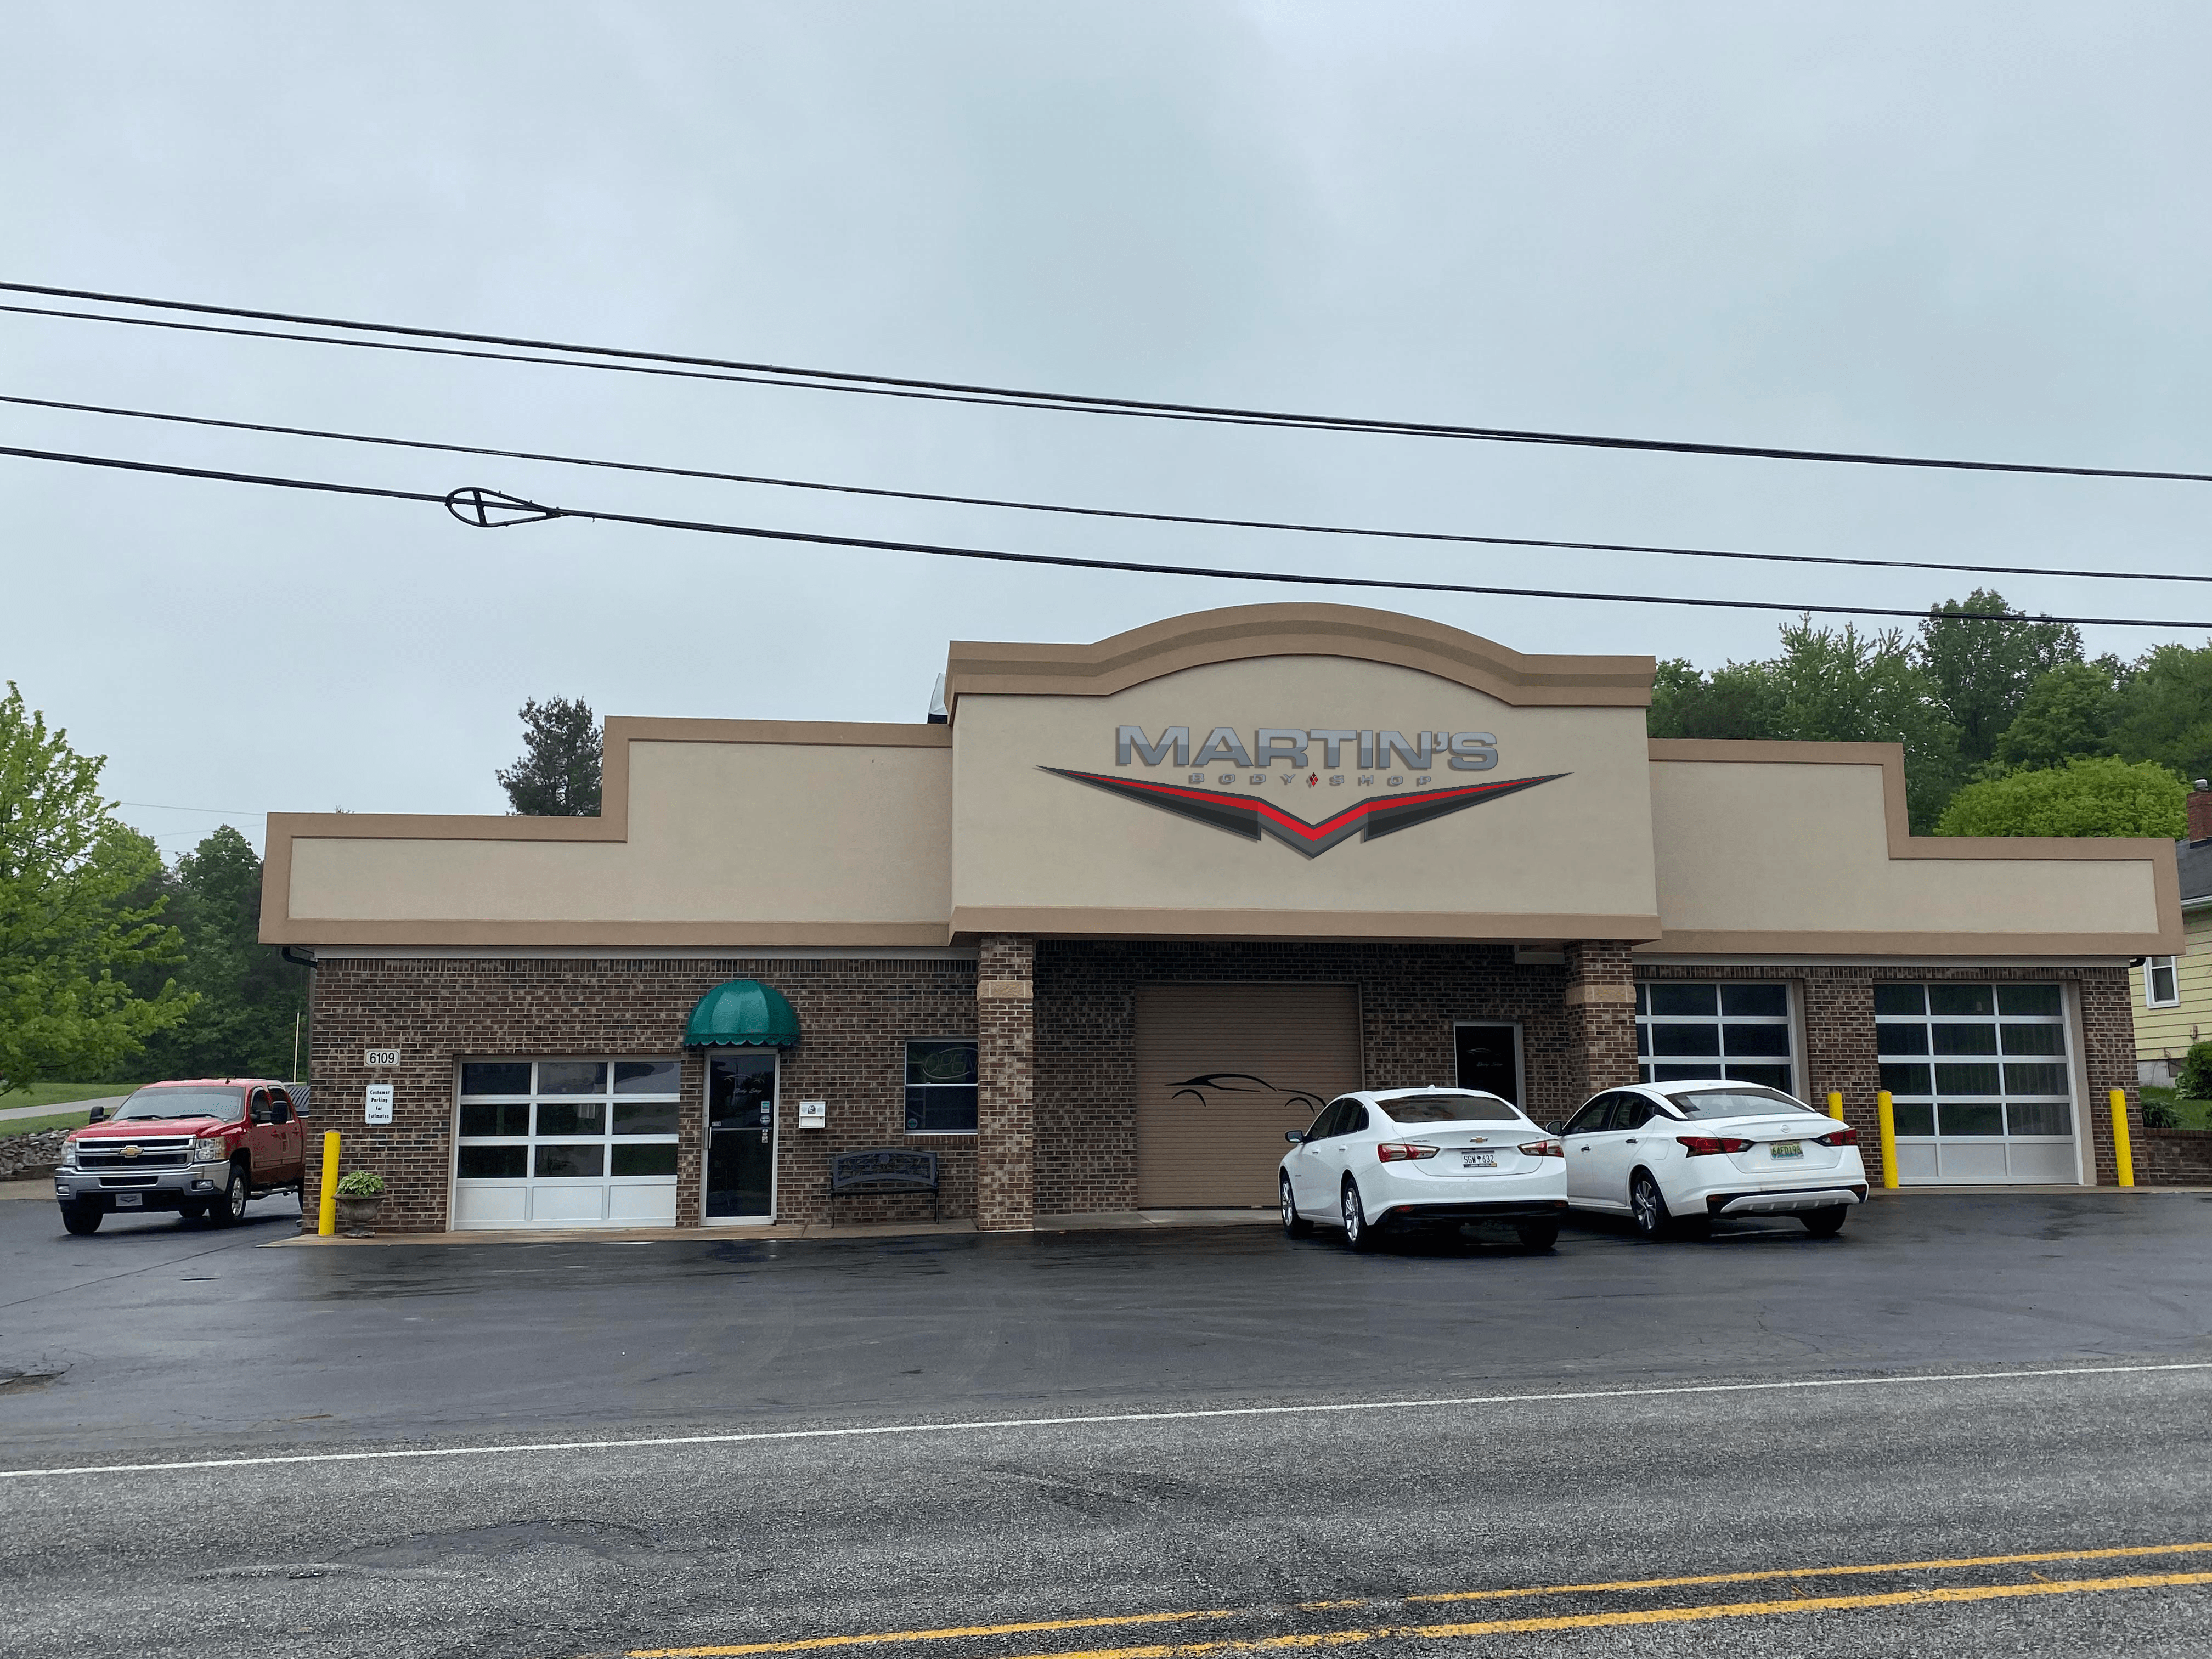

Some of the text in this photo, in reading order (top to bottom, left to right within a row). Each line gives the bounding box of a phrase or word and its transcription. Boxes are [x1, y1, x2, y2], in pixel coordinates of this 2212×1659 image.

[1117, 725, 1499, 770] MARTIN'S
[1191, 772, 1431, 785] BODY SHOP
[369, 1052, 395, 1064] 6109
[924, 1053, 978, 1074] OPEN
[1463, 1154, 1494, 1164] SGW 632
